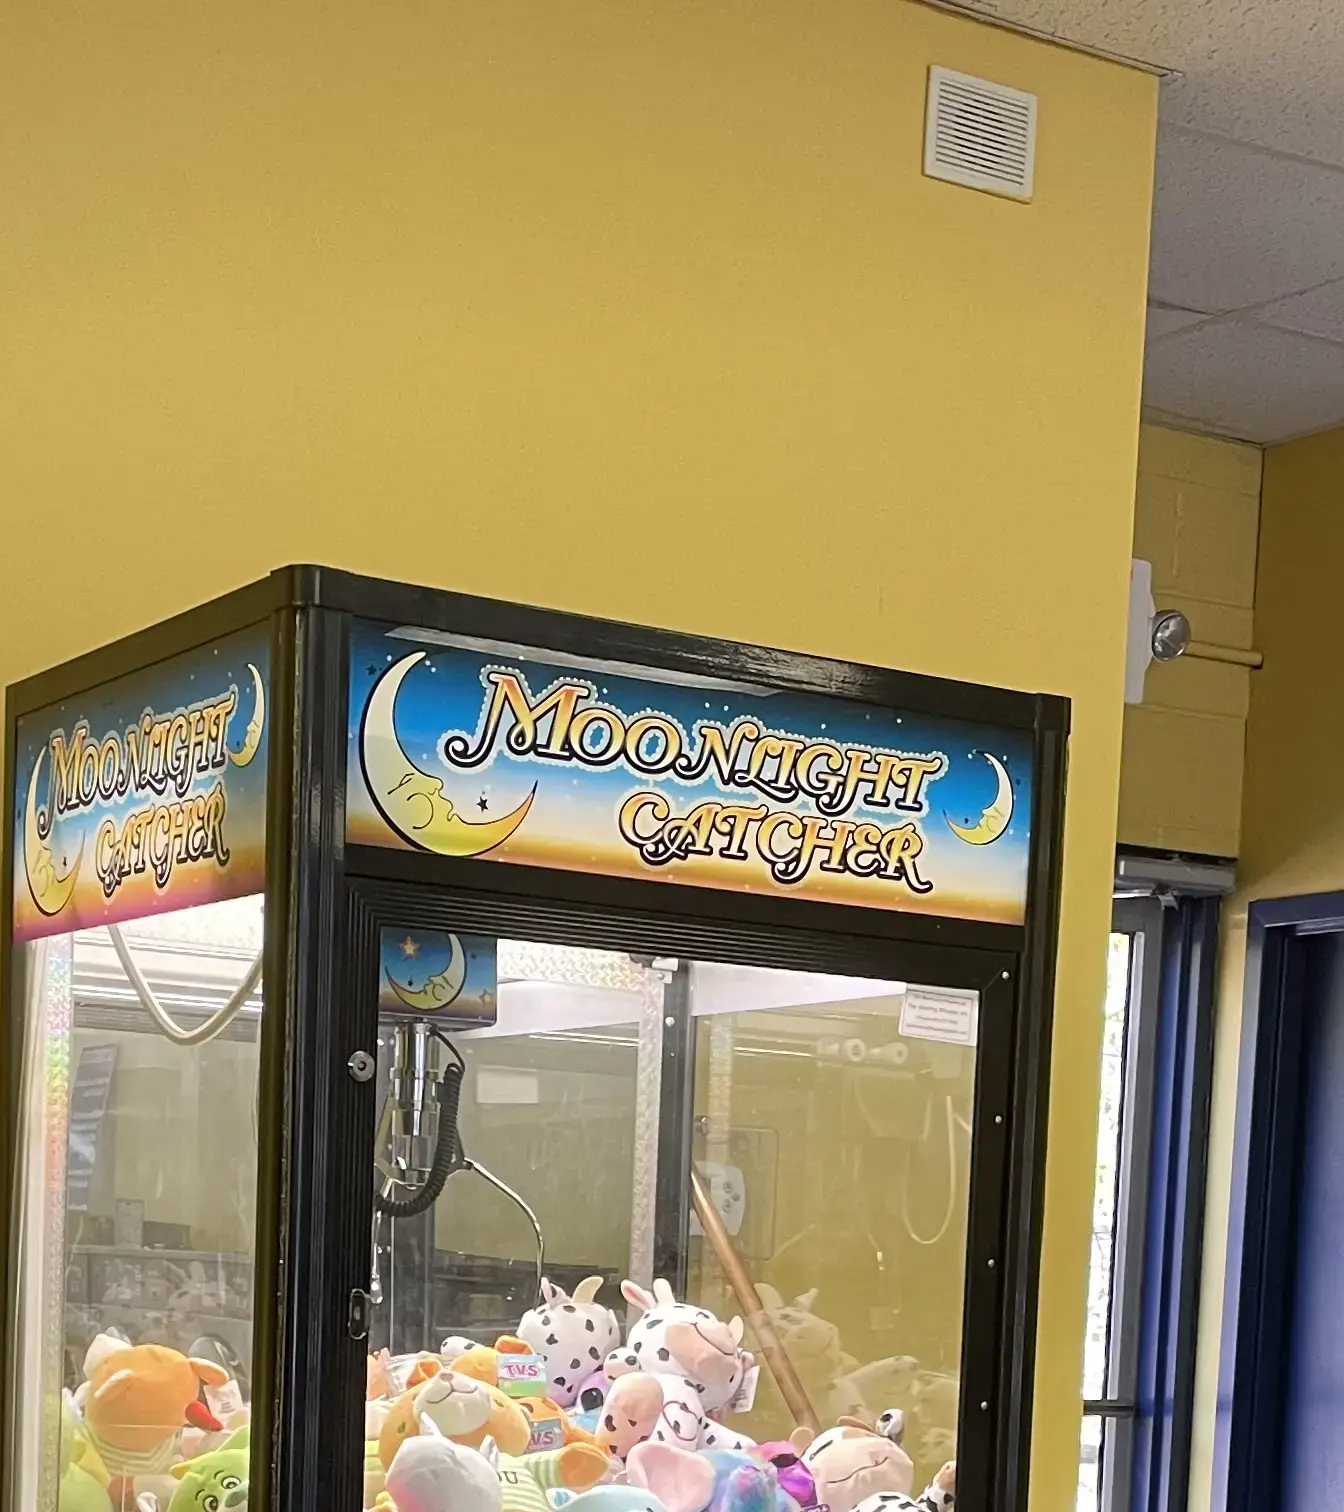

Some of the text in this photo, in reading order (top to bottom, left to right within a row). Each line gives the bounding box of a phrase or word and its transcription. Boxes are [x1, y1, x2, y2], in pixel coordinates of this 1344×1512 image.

[36, 691, 234, 841] MOONLIGHT
[443, 669, 942, 818] MOONLIGHT
[94, 781, 230, 898] CATCHER
[617, 791, 934, 894] CATCHER
